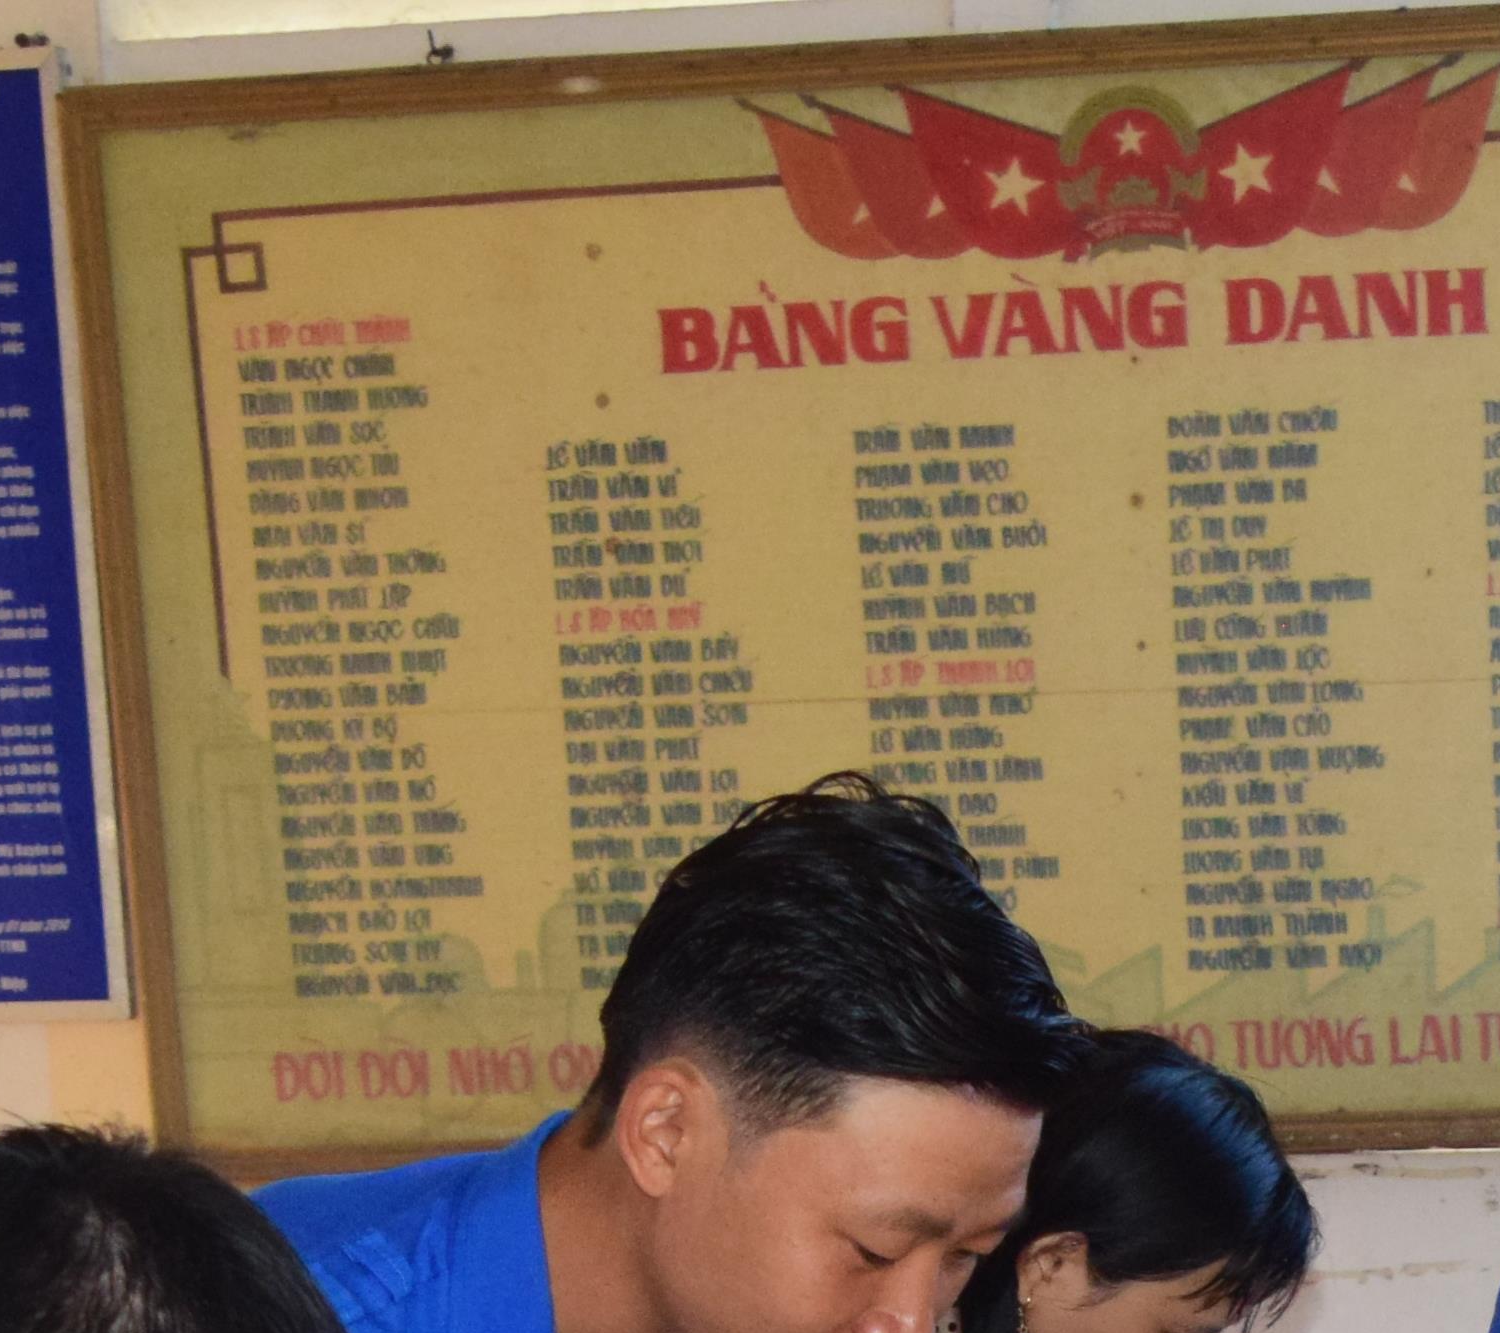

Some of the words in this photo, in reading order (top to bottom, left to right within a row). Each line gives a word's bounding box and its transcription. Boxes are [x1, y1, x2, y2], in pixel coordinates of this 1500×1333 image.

[657, 278, 911, 376] BẢNG
[931, 272, 1190, 360] VÀNG
[1225, 266, 1488, 345] DANH
[1388, 1013, 1462, 1066] LAI
